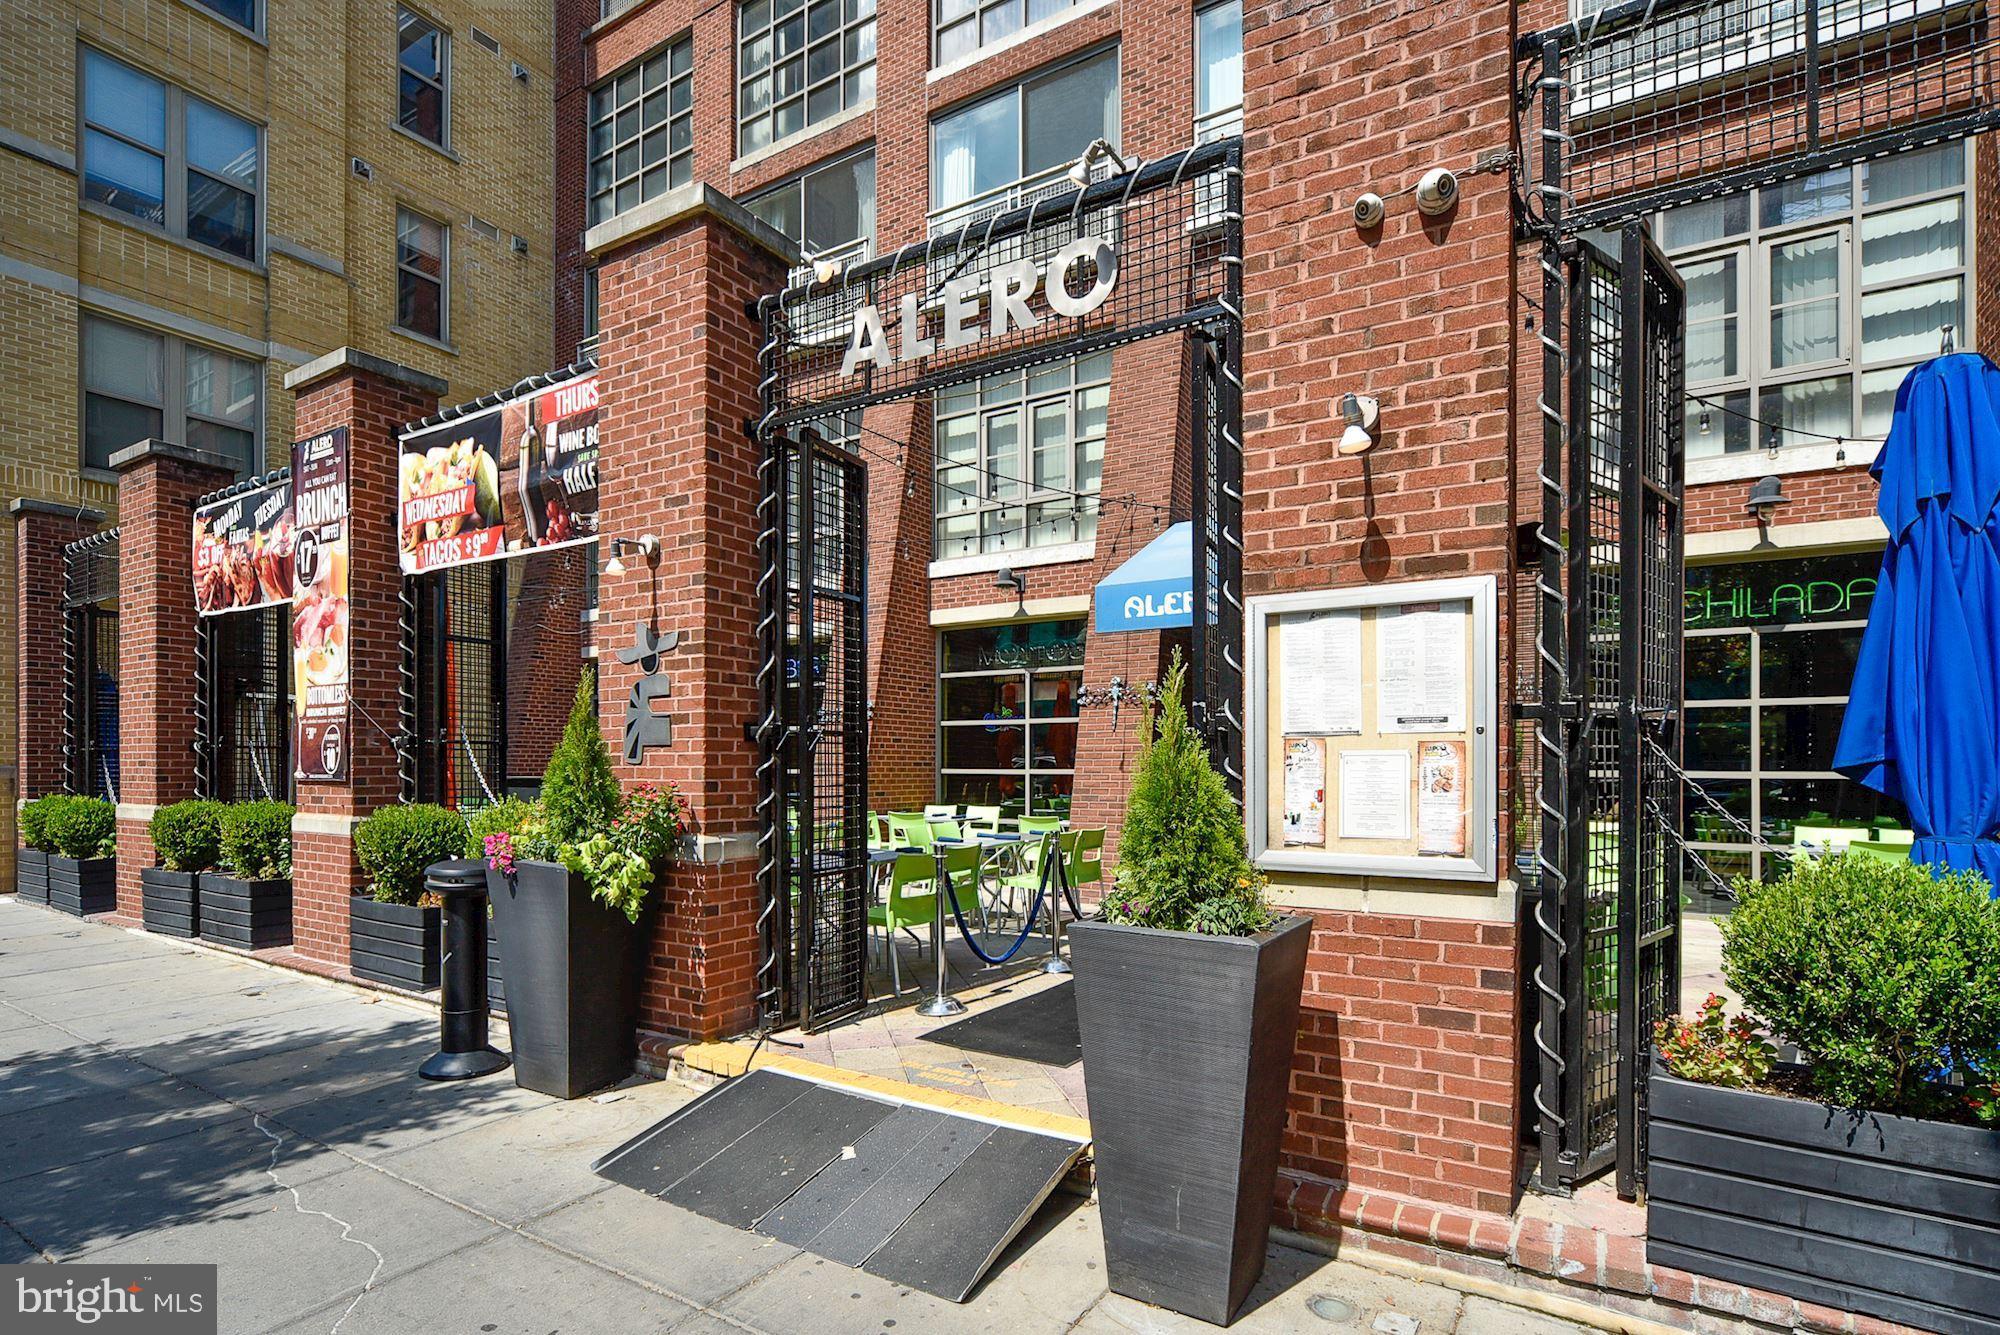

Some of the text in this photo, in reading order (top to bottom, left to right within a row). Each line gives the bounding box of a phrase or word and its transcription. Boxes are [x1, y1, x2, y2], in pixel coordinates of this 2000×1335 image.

[840, 236, 1118, 378] ALERO
[554, 379, 599, 417] THURS
[311, 434, 333, 453] ALERO
[558, 427, 586, 454] WINE
[562, 462, 597, 495] HALF
[213, 500, 242, 538] MONDAY
[254, 486, 286, 530] TUESDAY
[296, 482, 347, 529] BRUNCH
[405, 488, 468, 526] WEDNESDAY
[320, 522, 340, 541] BUFFET
[197, 544, 225, 567] $3 OFF
[423, 538, 461, 566] TACOS
[307, 684, 347, 705] BOTTOMLESS
